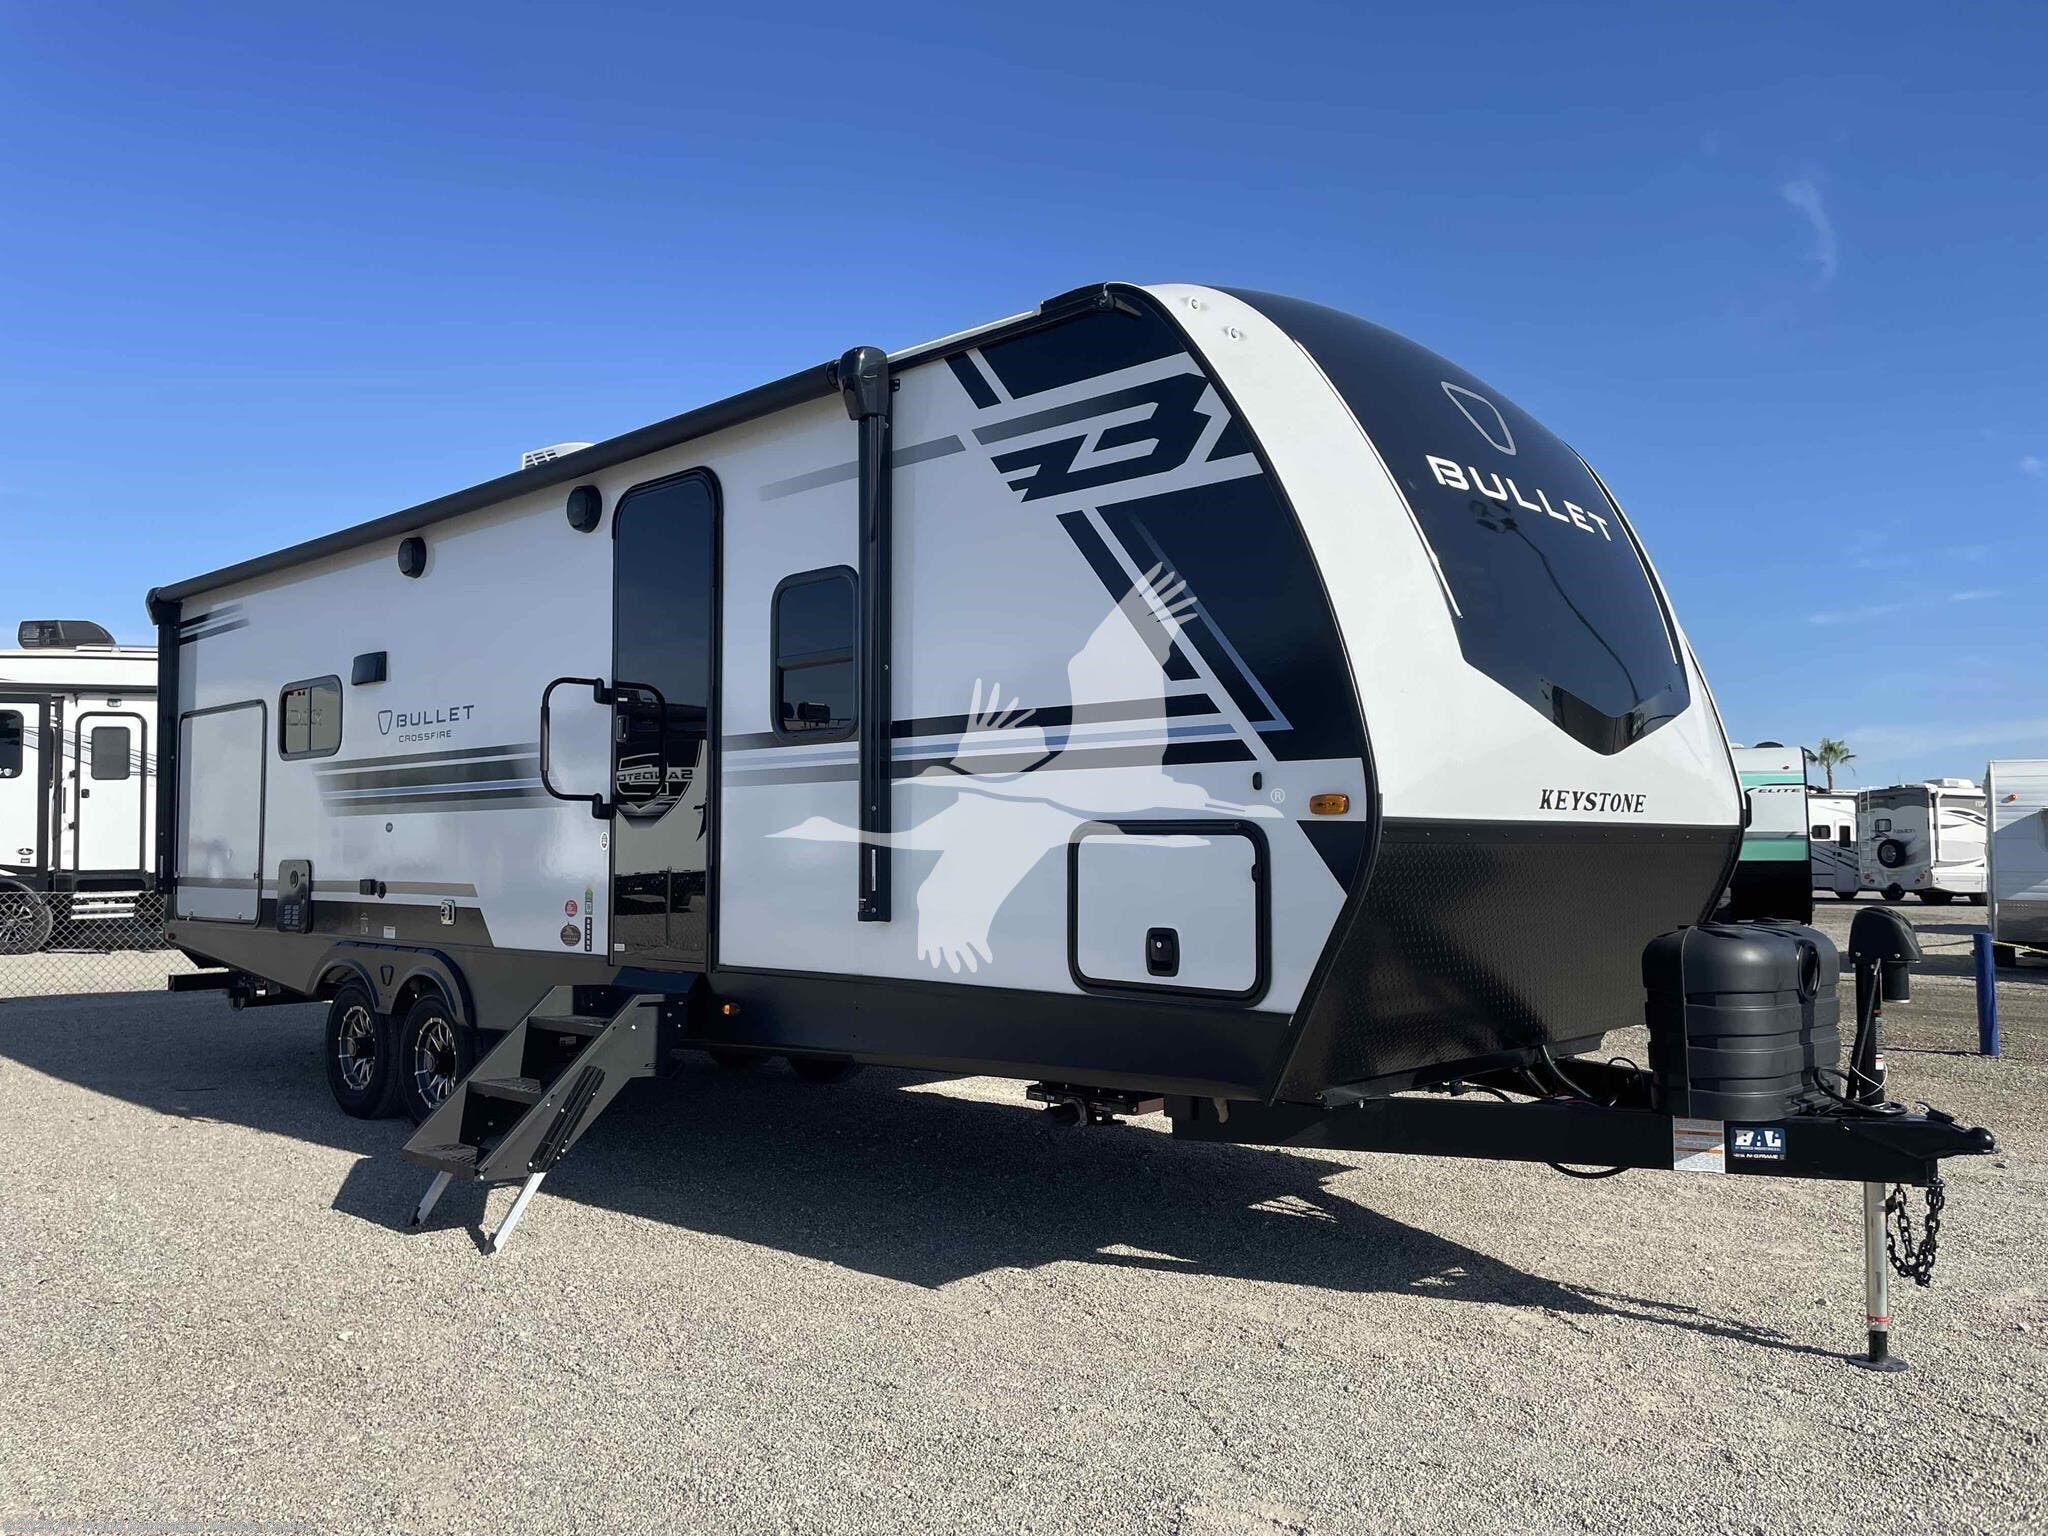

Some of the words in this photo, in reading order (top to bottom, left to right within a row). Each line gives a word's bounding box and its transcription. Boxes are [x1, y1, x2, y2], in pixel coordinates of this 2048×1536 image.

[1425, 454, 1611, 541] BULLET
[396, 704, 475, 728] BULLET
[398, 729, 452, 743] CROSSFIRE
[1539, 789, 1647, 813] KEYSTONE
